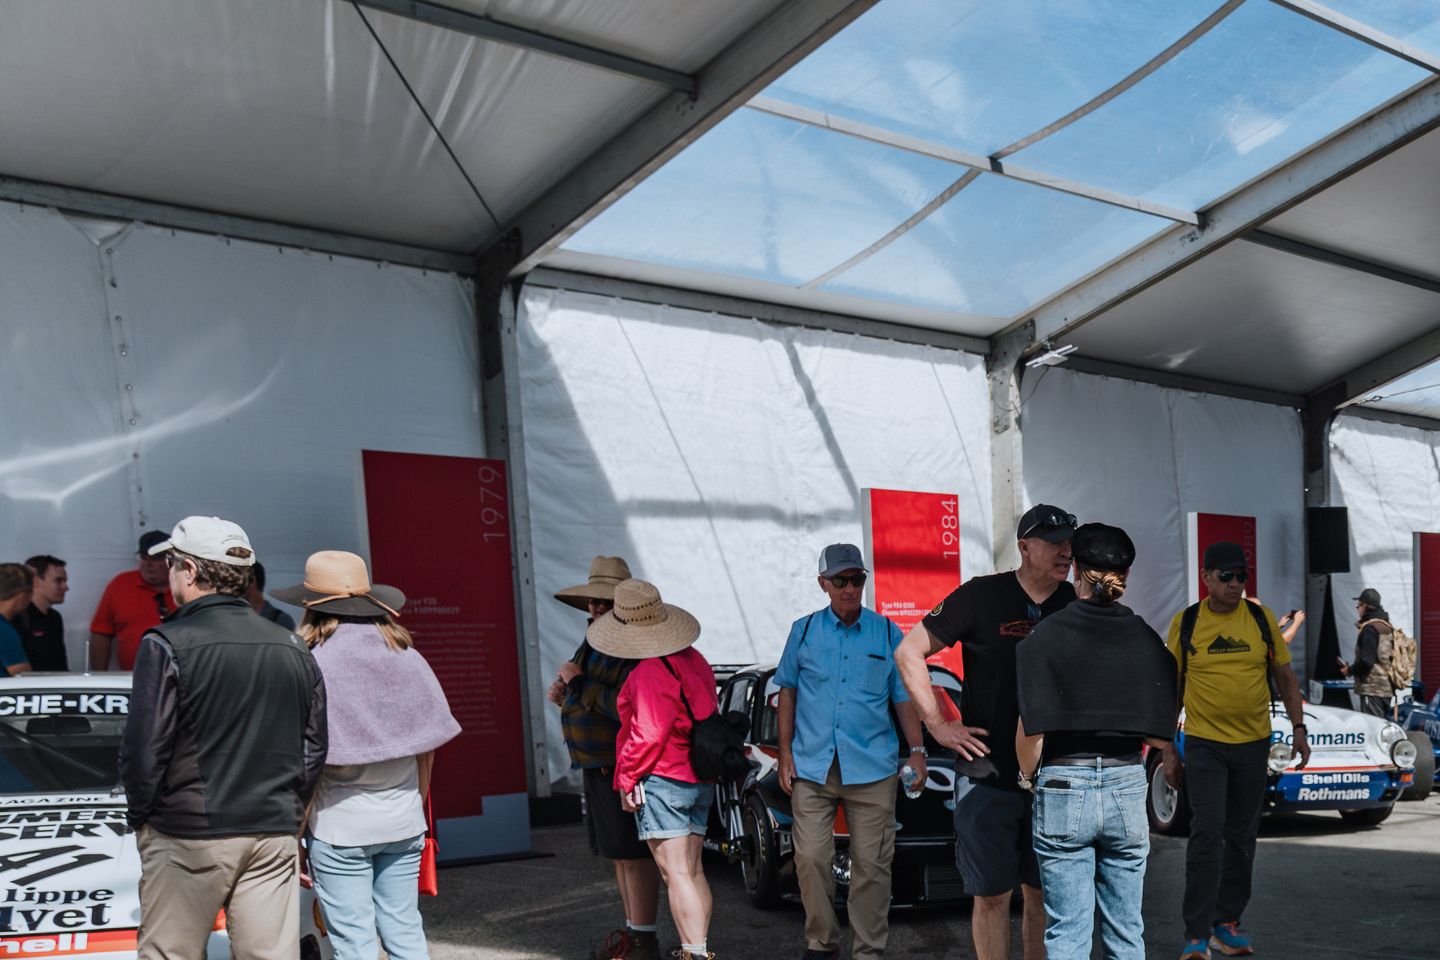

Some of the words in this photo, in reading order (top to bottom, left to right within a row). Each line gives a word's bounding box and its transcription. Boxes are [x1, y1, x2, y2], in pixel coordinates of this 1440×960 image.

[478, 465, 506, 543] 1979
[941, 498, 959, 560] 1984
[1270, 730, 1365, 745] Romans
[1302, 774, 1341, 785] Shell
[1343, 772, 1370, 783] Oils
[0, 796, 106, 804] AGAZINE
[1298, 788, 1370, 801] Rothmans
[5, 887, 115, 904] lippe
